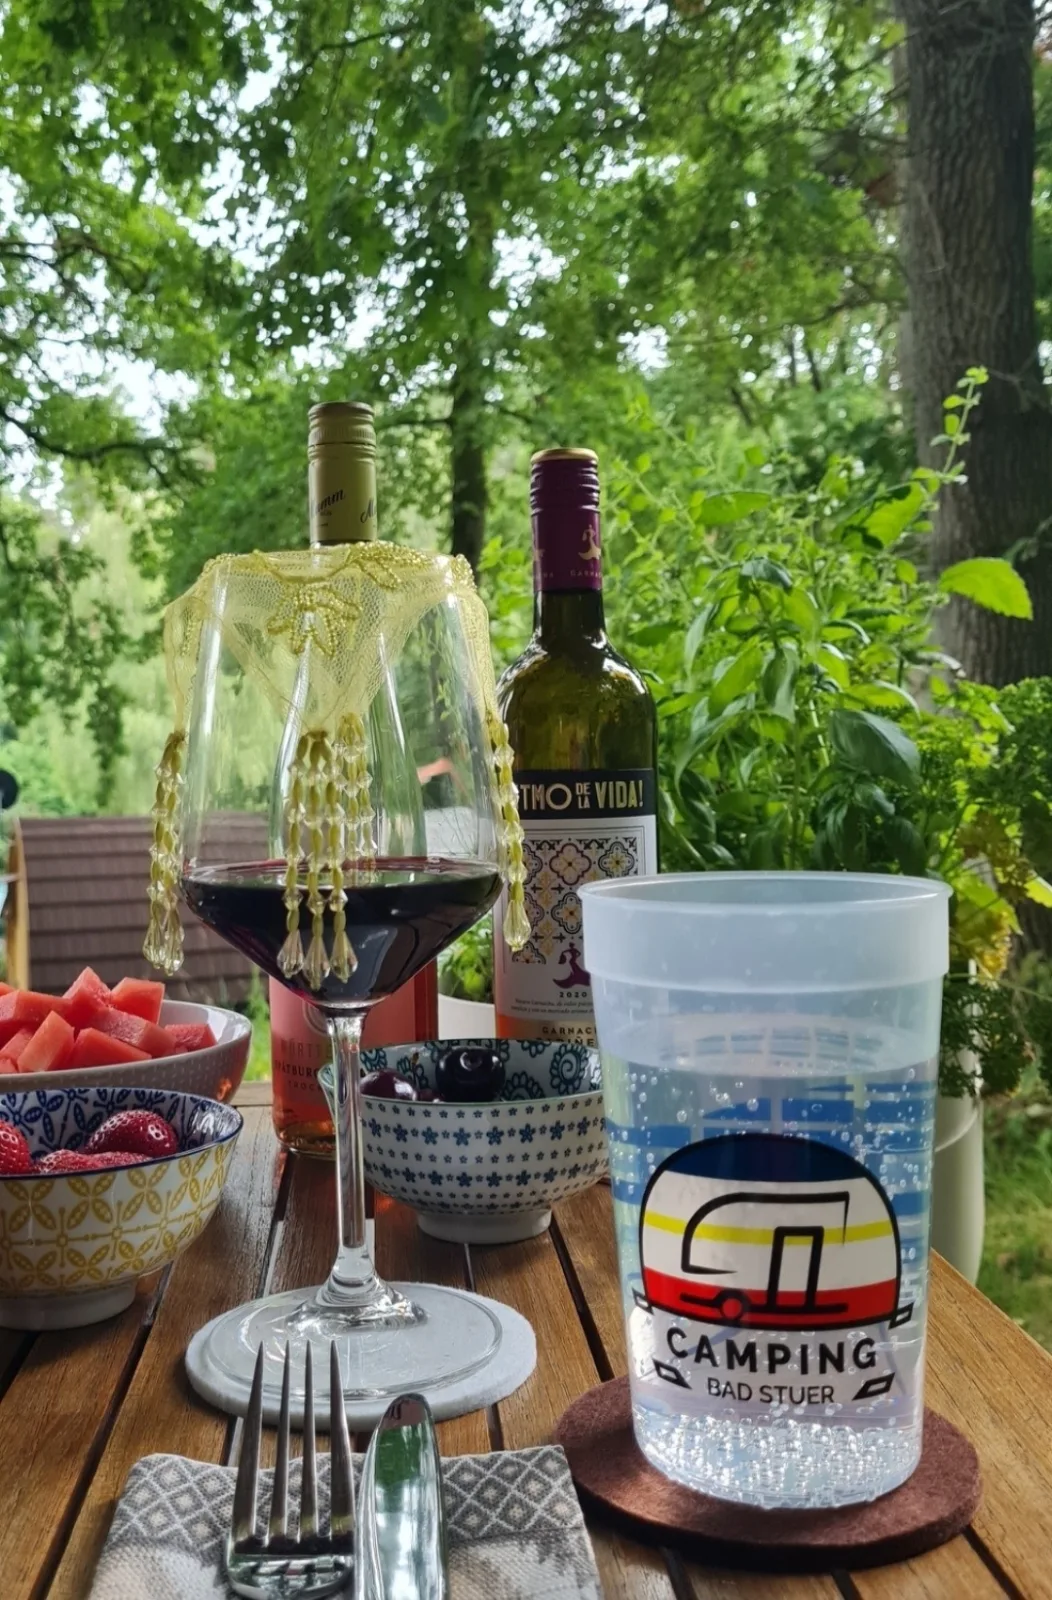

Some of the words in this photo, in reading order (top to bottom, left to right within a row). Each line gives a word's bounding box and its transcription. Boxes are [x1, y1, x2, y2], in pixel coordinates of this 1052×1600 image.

[519, 782, 573, 811] TMO
[575, 782, 591, 796] DE
[577, 795, 591, 809] LA
[594, 779, 644, 809] VIDA!
[274, 1059, 320, 1079] SPÄTBURG
[666, 1326, 878, 1376] CAMPING
[707, 1376, 754, 1402] BAD
[758, 1384, 837, 1406] STUER
